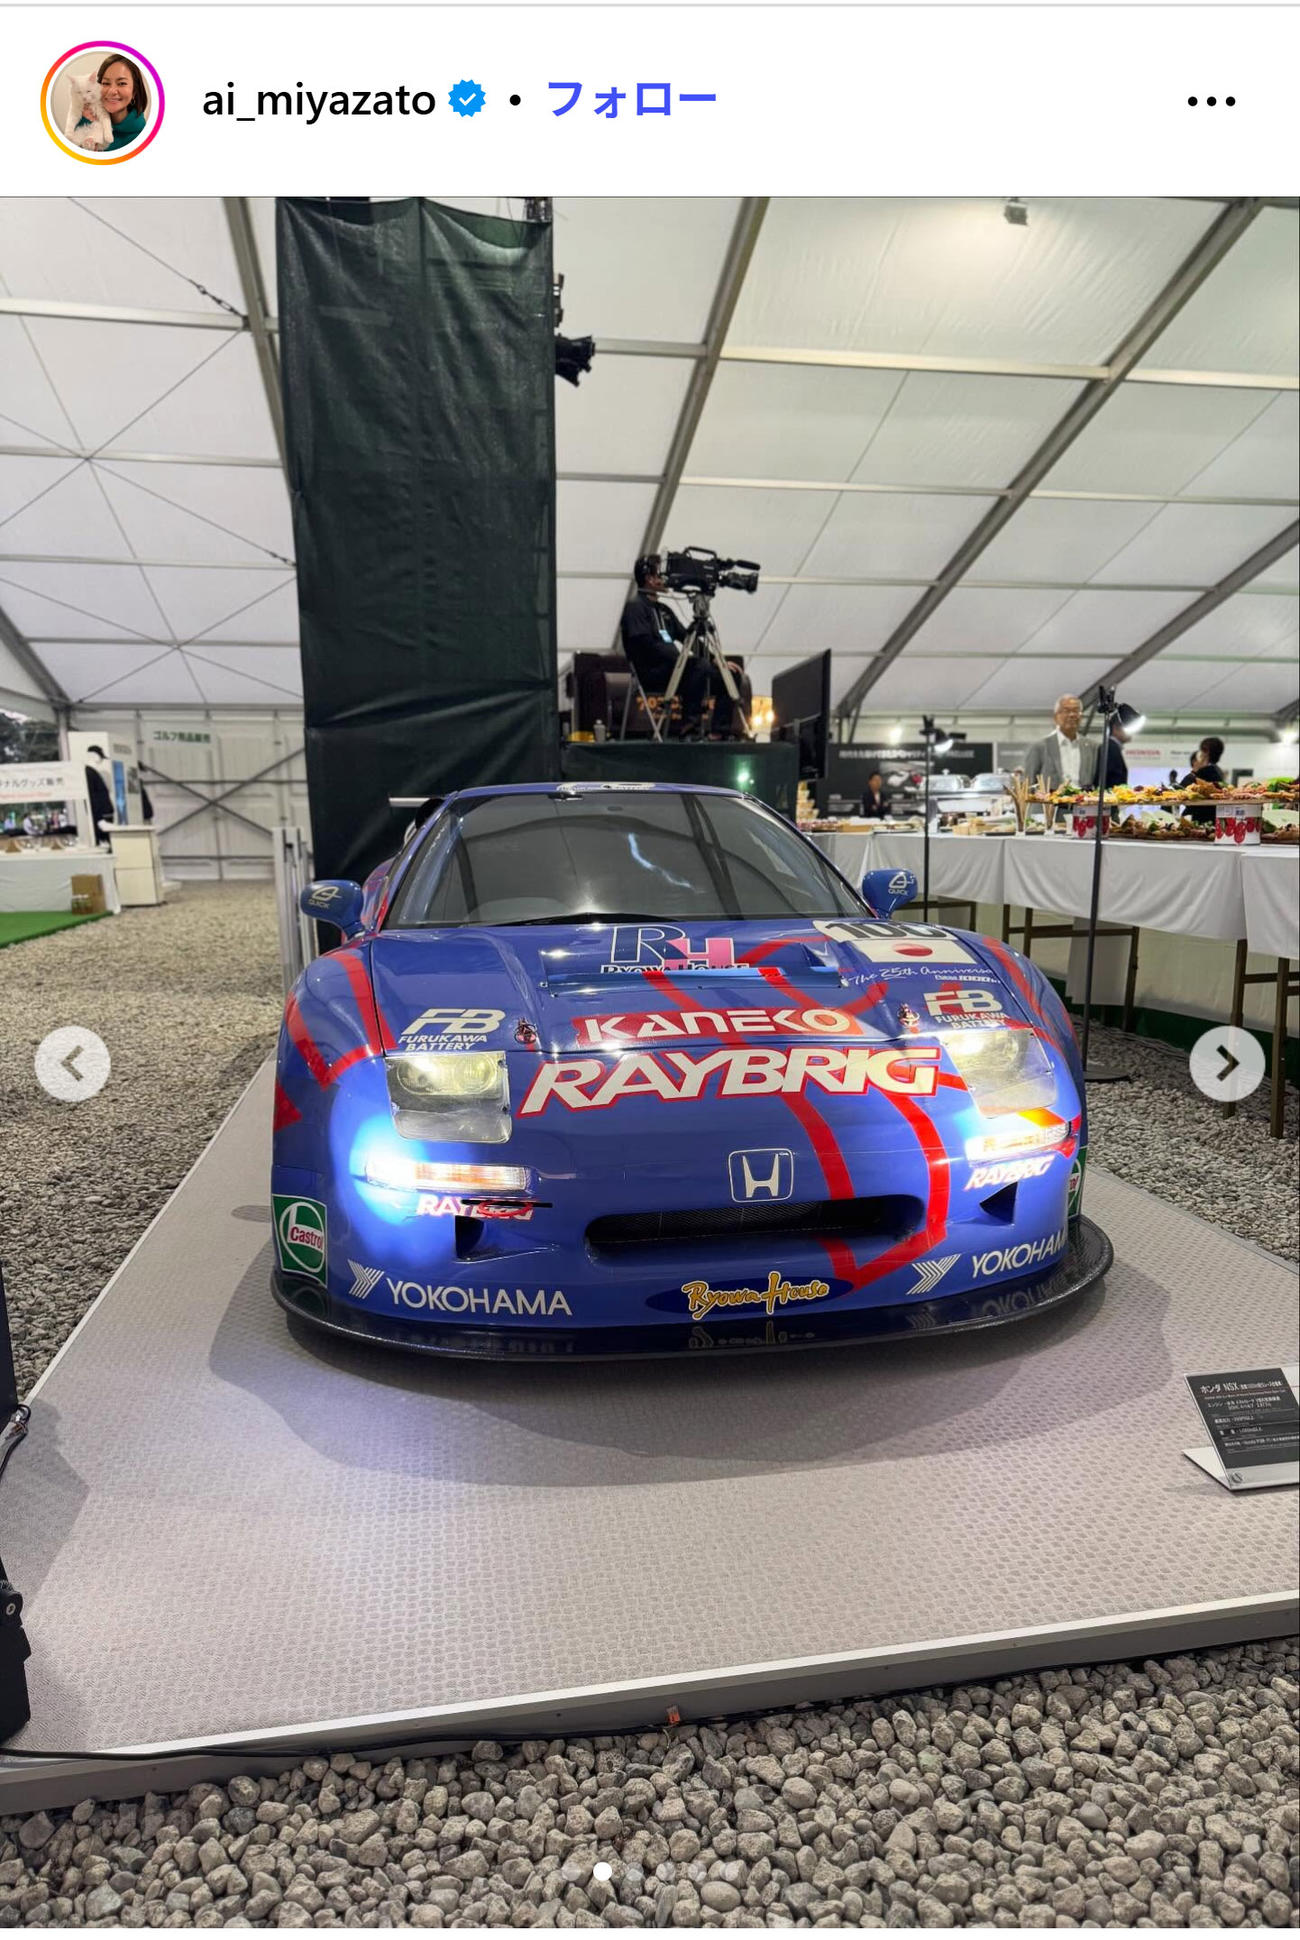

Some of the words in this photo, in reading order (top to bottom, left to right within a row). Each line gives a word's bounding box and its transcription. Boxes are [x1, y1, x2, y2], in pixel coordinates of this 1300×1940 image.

[849, 973, 878, 985] The
[580, 1007, 853, 1044] KANEKO
[935, 1011, 1010, 1025] FURUKAWA
[951, 1020, 1007, 1030] BATTERY
[398, 1034, 489, 1045] FURUKAWA
[405, 1042, 473, 1052] BATTERY
[518, 1046, 940, 1117] RAYBRIG
[963, 1154, 1056, 1191] RAYBRIG
[290, 1227, 324, 1250] Castrol
[386, 1278, 573, 1316] YOKOHAMA
[682, 1280, 763, 1319] Ryowa
[755, 1271, 829, 1315] House
[1222, 1382, 1239, 1391] NSX
